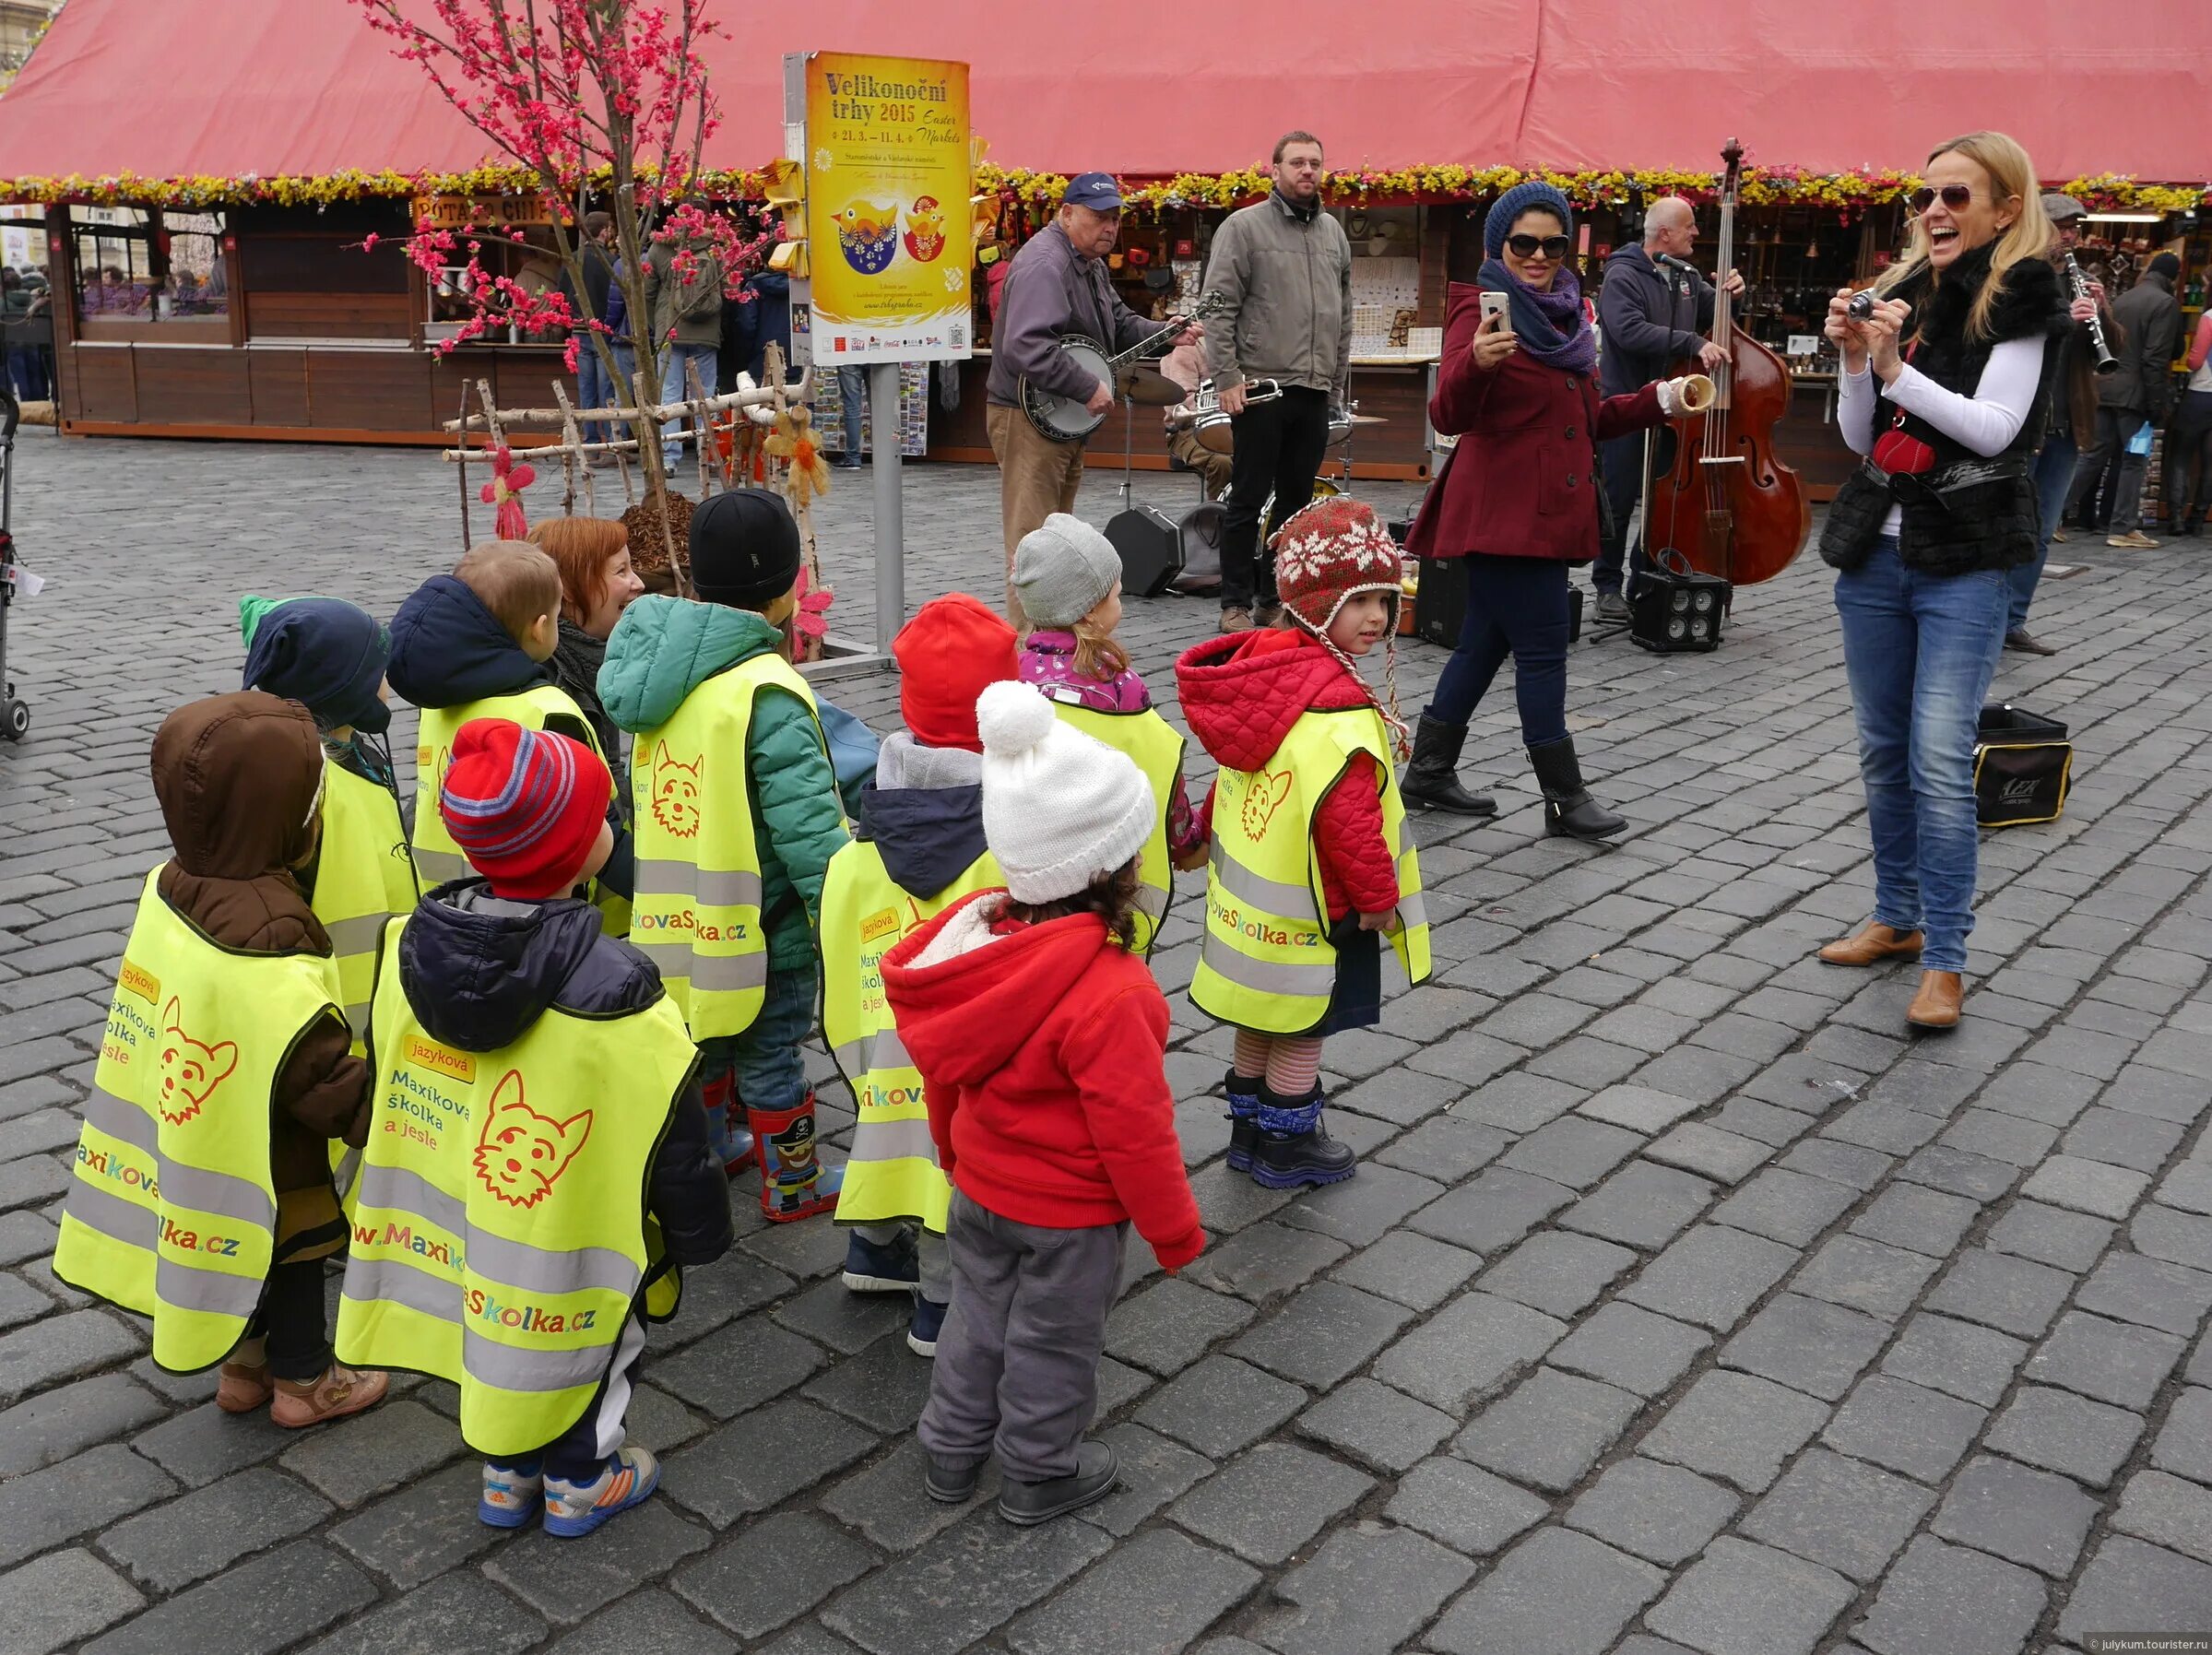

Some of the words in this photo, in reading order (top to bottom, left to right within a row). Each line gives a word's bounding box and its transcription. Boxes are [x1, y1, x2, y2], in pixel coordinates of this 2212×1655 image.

[824, 72, 947, 102] Velikonoční
[832, 98, 875, 126] trhy
[880, 102, 916, 123] 2015
[923, 110, 956, 125] Easter
[916, 126, 960, 146] Markets
[412, 1041, 468, 1072] jazyková
[387, 1093, 444, 1131] školka
[384, 1120, 396, 1132] a
[401, 1119, 437, 1151] jesle
